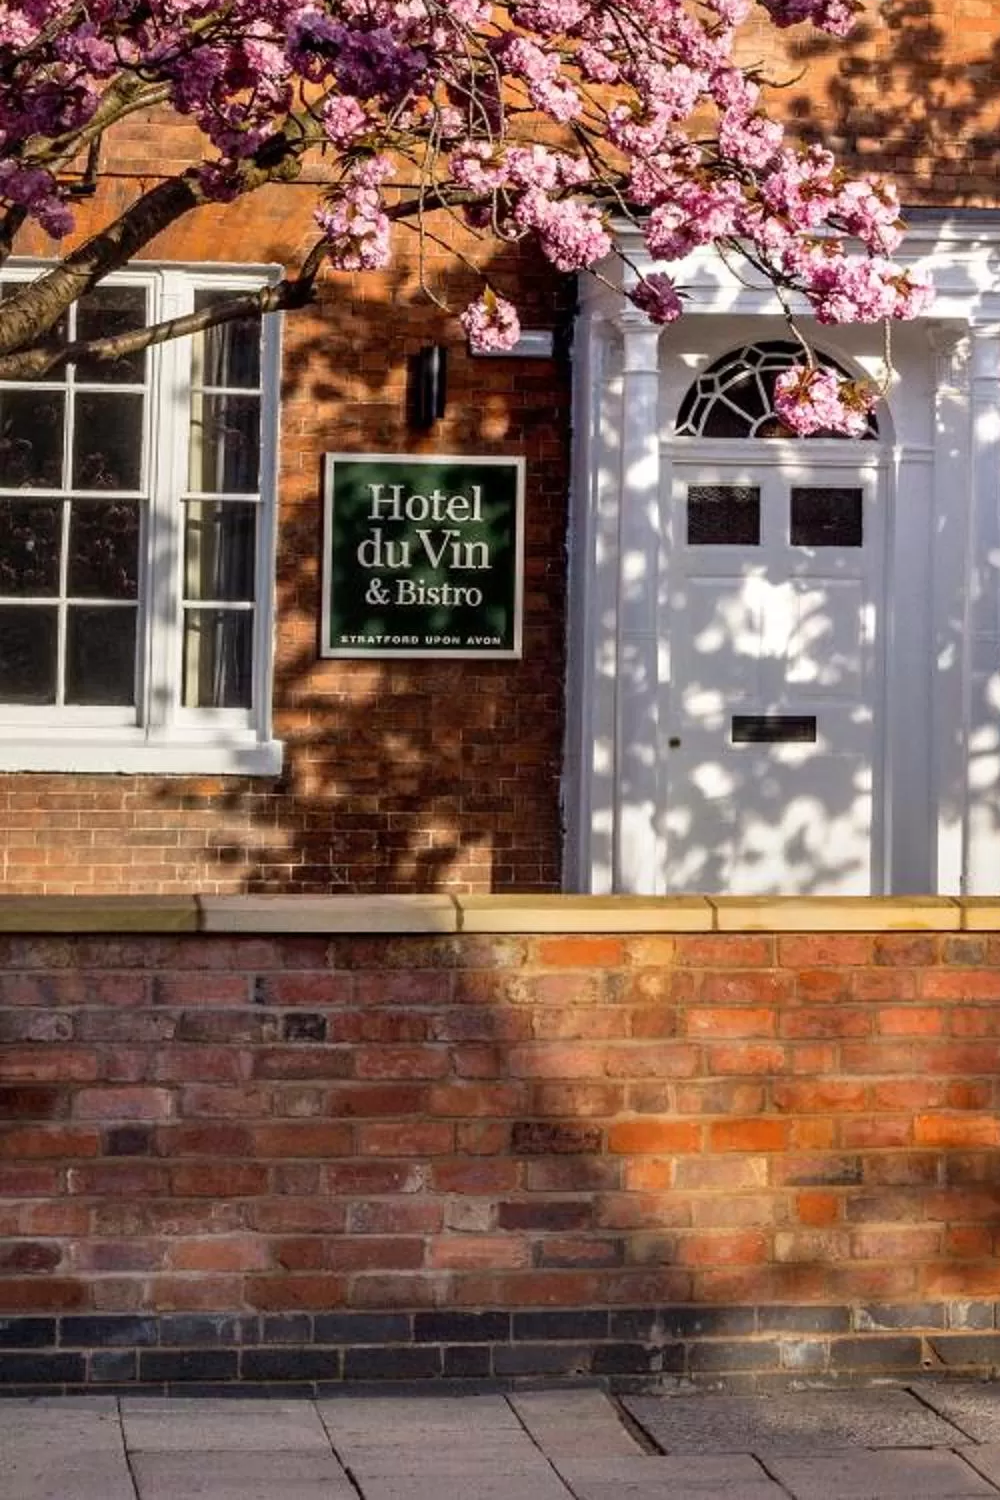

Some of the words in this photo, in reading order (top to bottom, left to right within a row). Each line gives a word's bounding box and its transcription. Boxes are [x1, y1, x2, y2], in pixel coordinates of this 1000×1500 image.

[367, 483, 484, 522] Hotel
[356, 527, 412, 569] du
[415, 528, 493, 570] Vin
[364, 577, 390, 606] &
[395, 579, 483, 607] Bistro
[340, 634, 419, 645] STRATFORD
[424, 635, 461, 645] UPON
[465, 635, 501, 645] AVON
